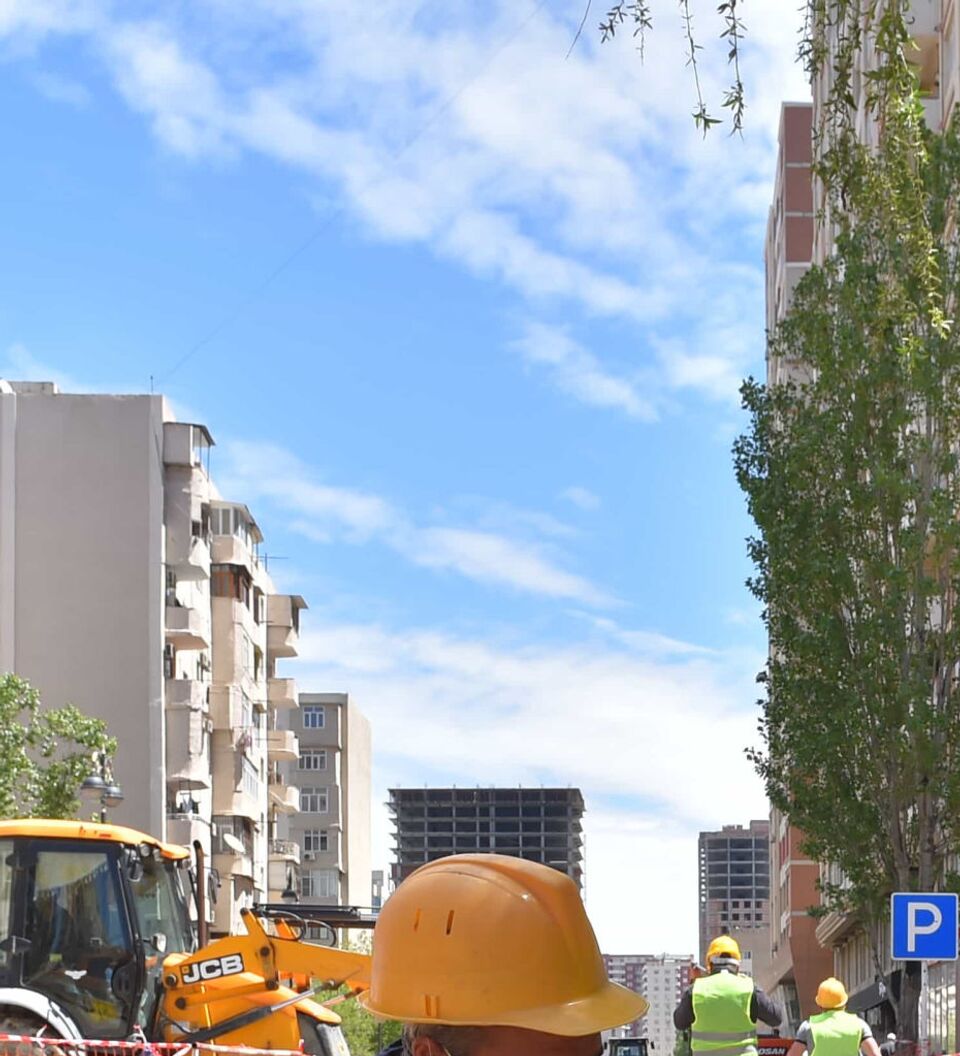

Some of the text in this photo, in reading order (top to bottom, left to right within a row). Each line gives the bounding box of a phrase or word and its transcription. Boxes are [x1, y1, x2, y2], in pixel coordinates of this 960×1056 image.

[908, 902, 942, 952] P
[183, 954, 244, 984] JCB
[758, 1047, 785, 1055] OSAN
